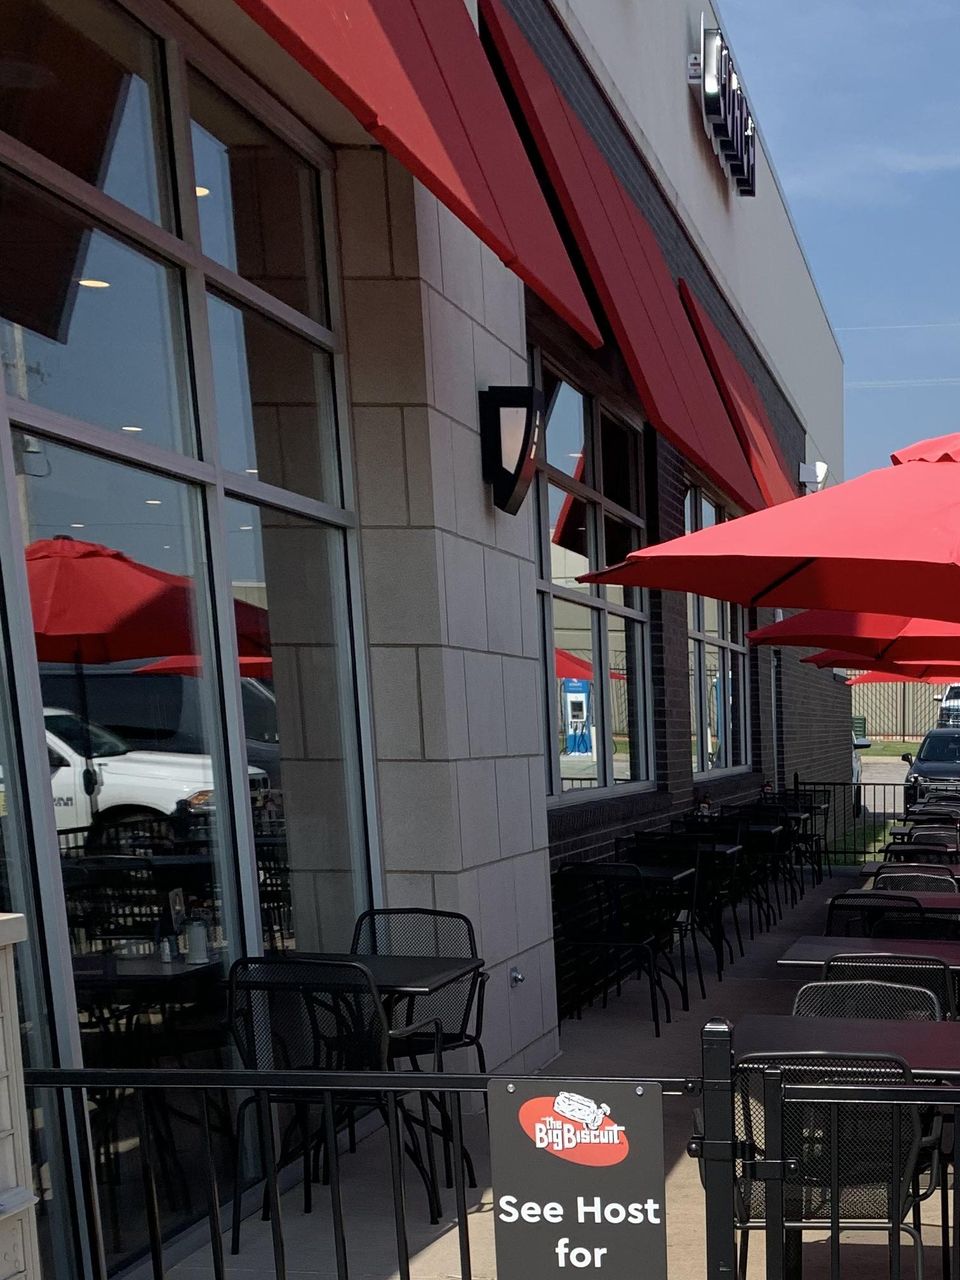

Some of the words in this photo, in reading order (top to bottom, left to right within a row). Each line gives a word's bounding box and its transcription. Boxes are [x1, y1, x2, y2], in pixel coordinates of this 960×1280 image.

[498, 1195, 564, 1223] See
[576, 1196, 661, 1224] Host
[555, 1237, 607, 1268] for
